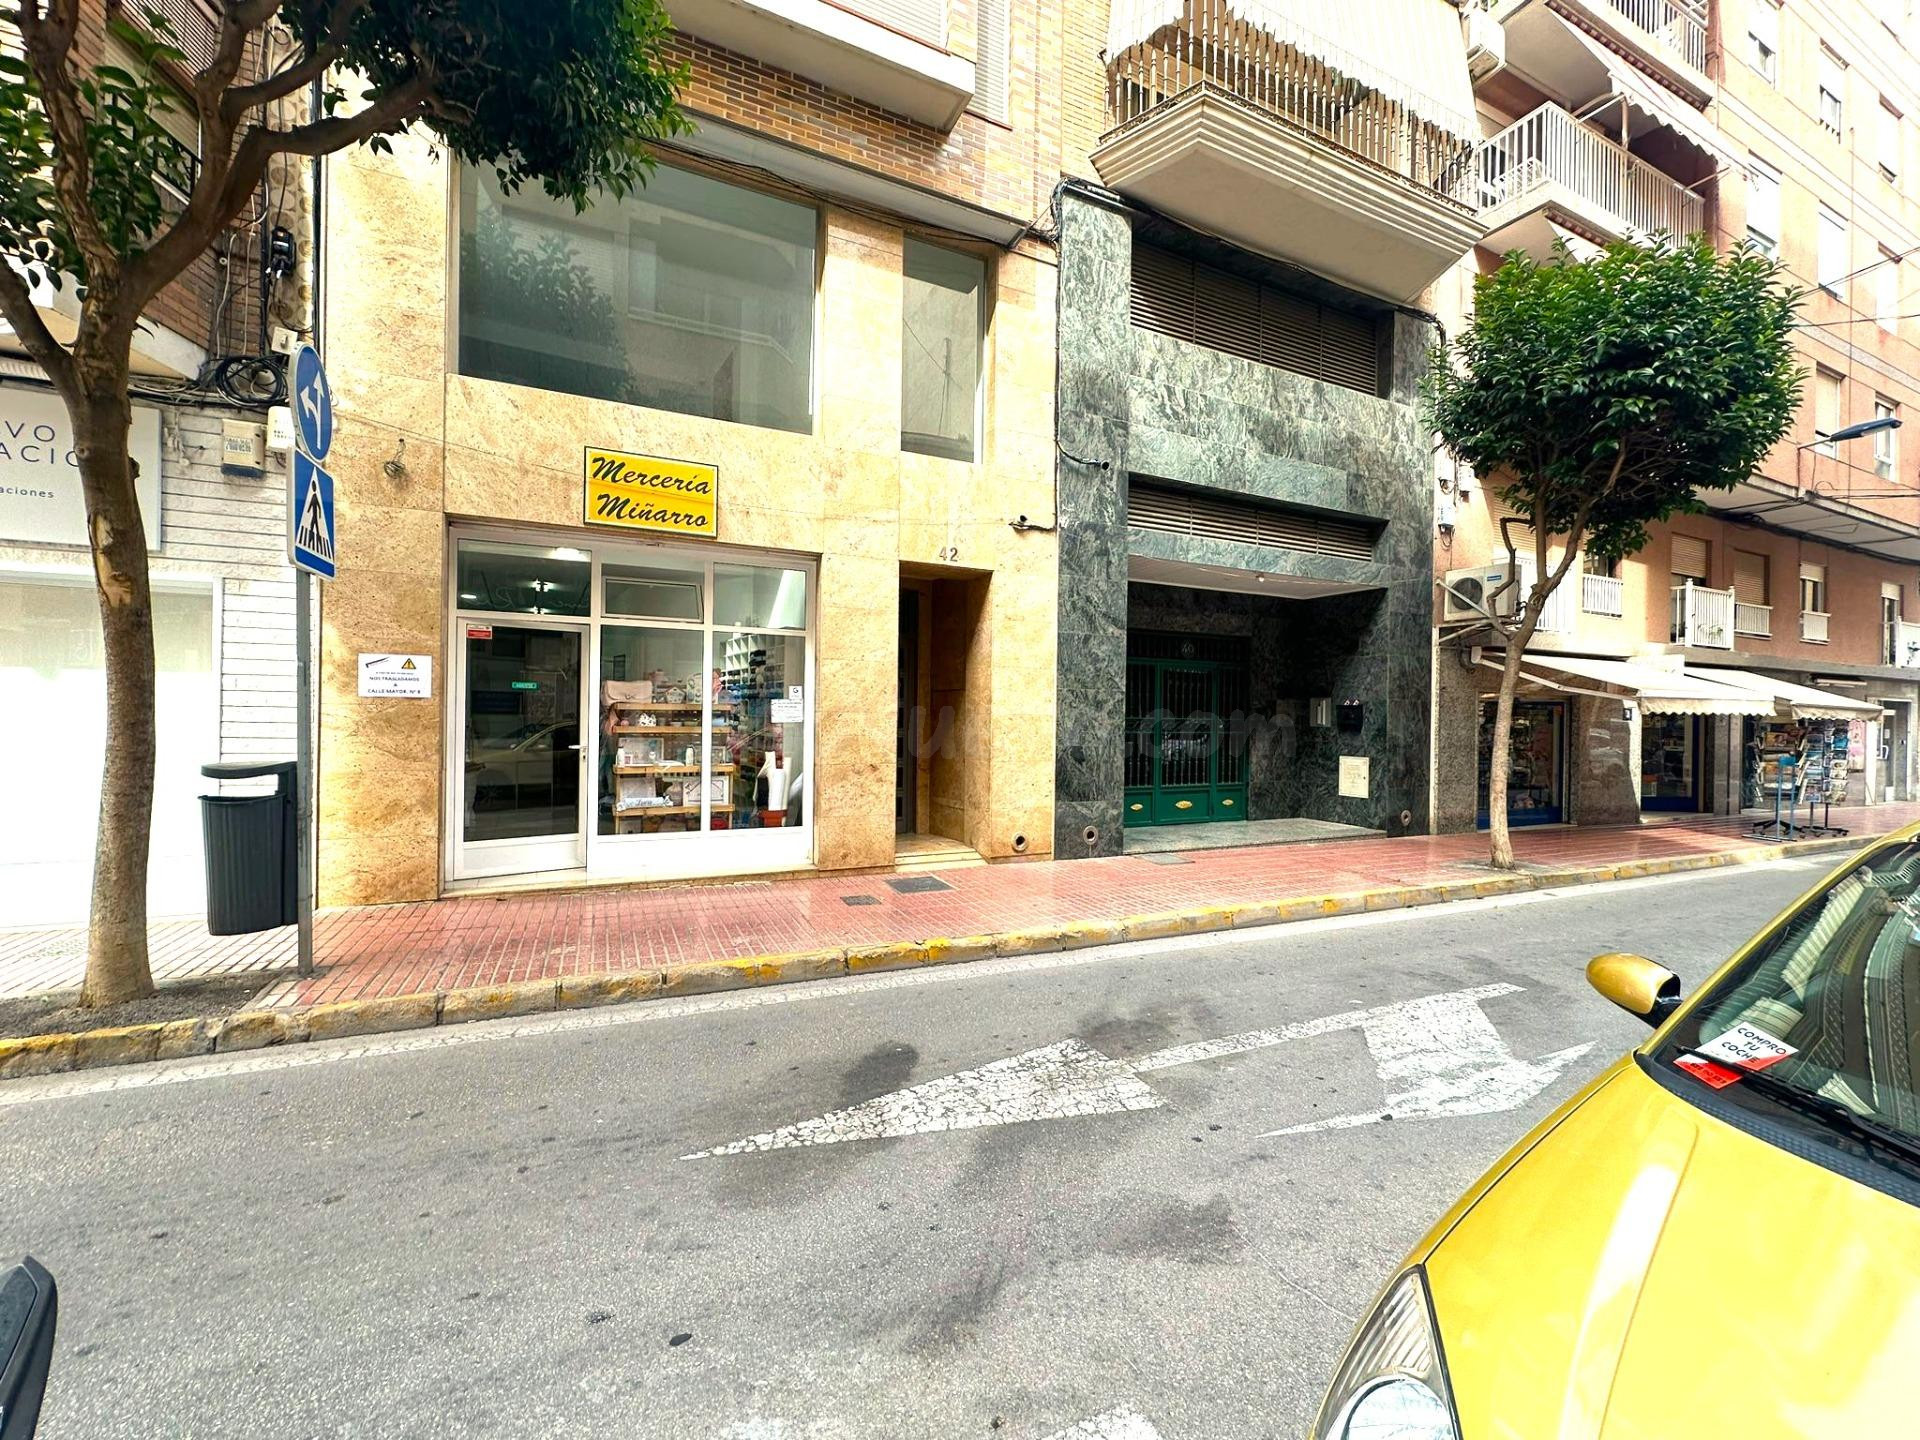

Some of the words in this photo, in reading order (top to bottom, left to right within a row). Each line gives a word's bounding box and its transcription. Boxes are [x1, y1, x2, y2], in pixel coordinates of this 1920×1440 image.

[592, 456, 712, 495] Mercería
[597, 493, 709, 527] Miñarro
[939, 546, 959, 562] 42
[1721, 1041, 1761, 1063] COCHE
[1737, 1027, 1787, 1055] COMPRO
[1743, 1041, 1760, 1051] TU
